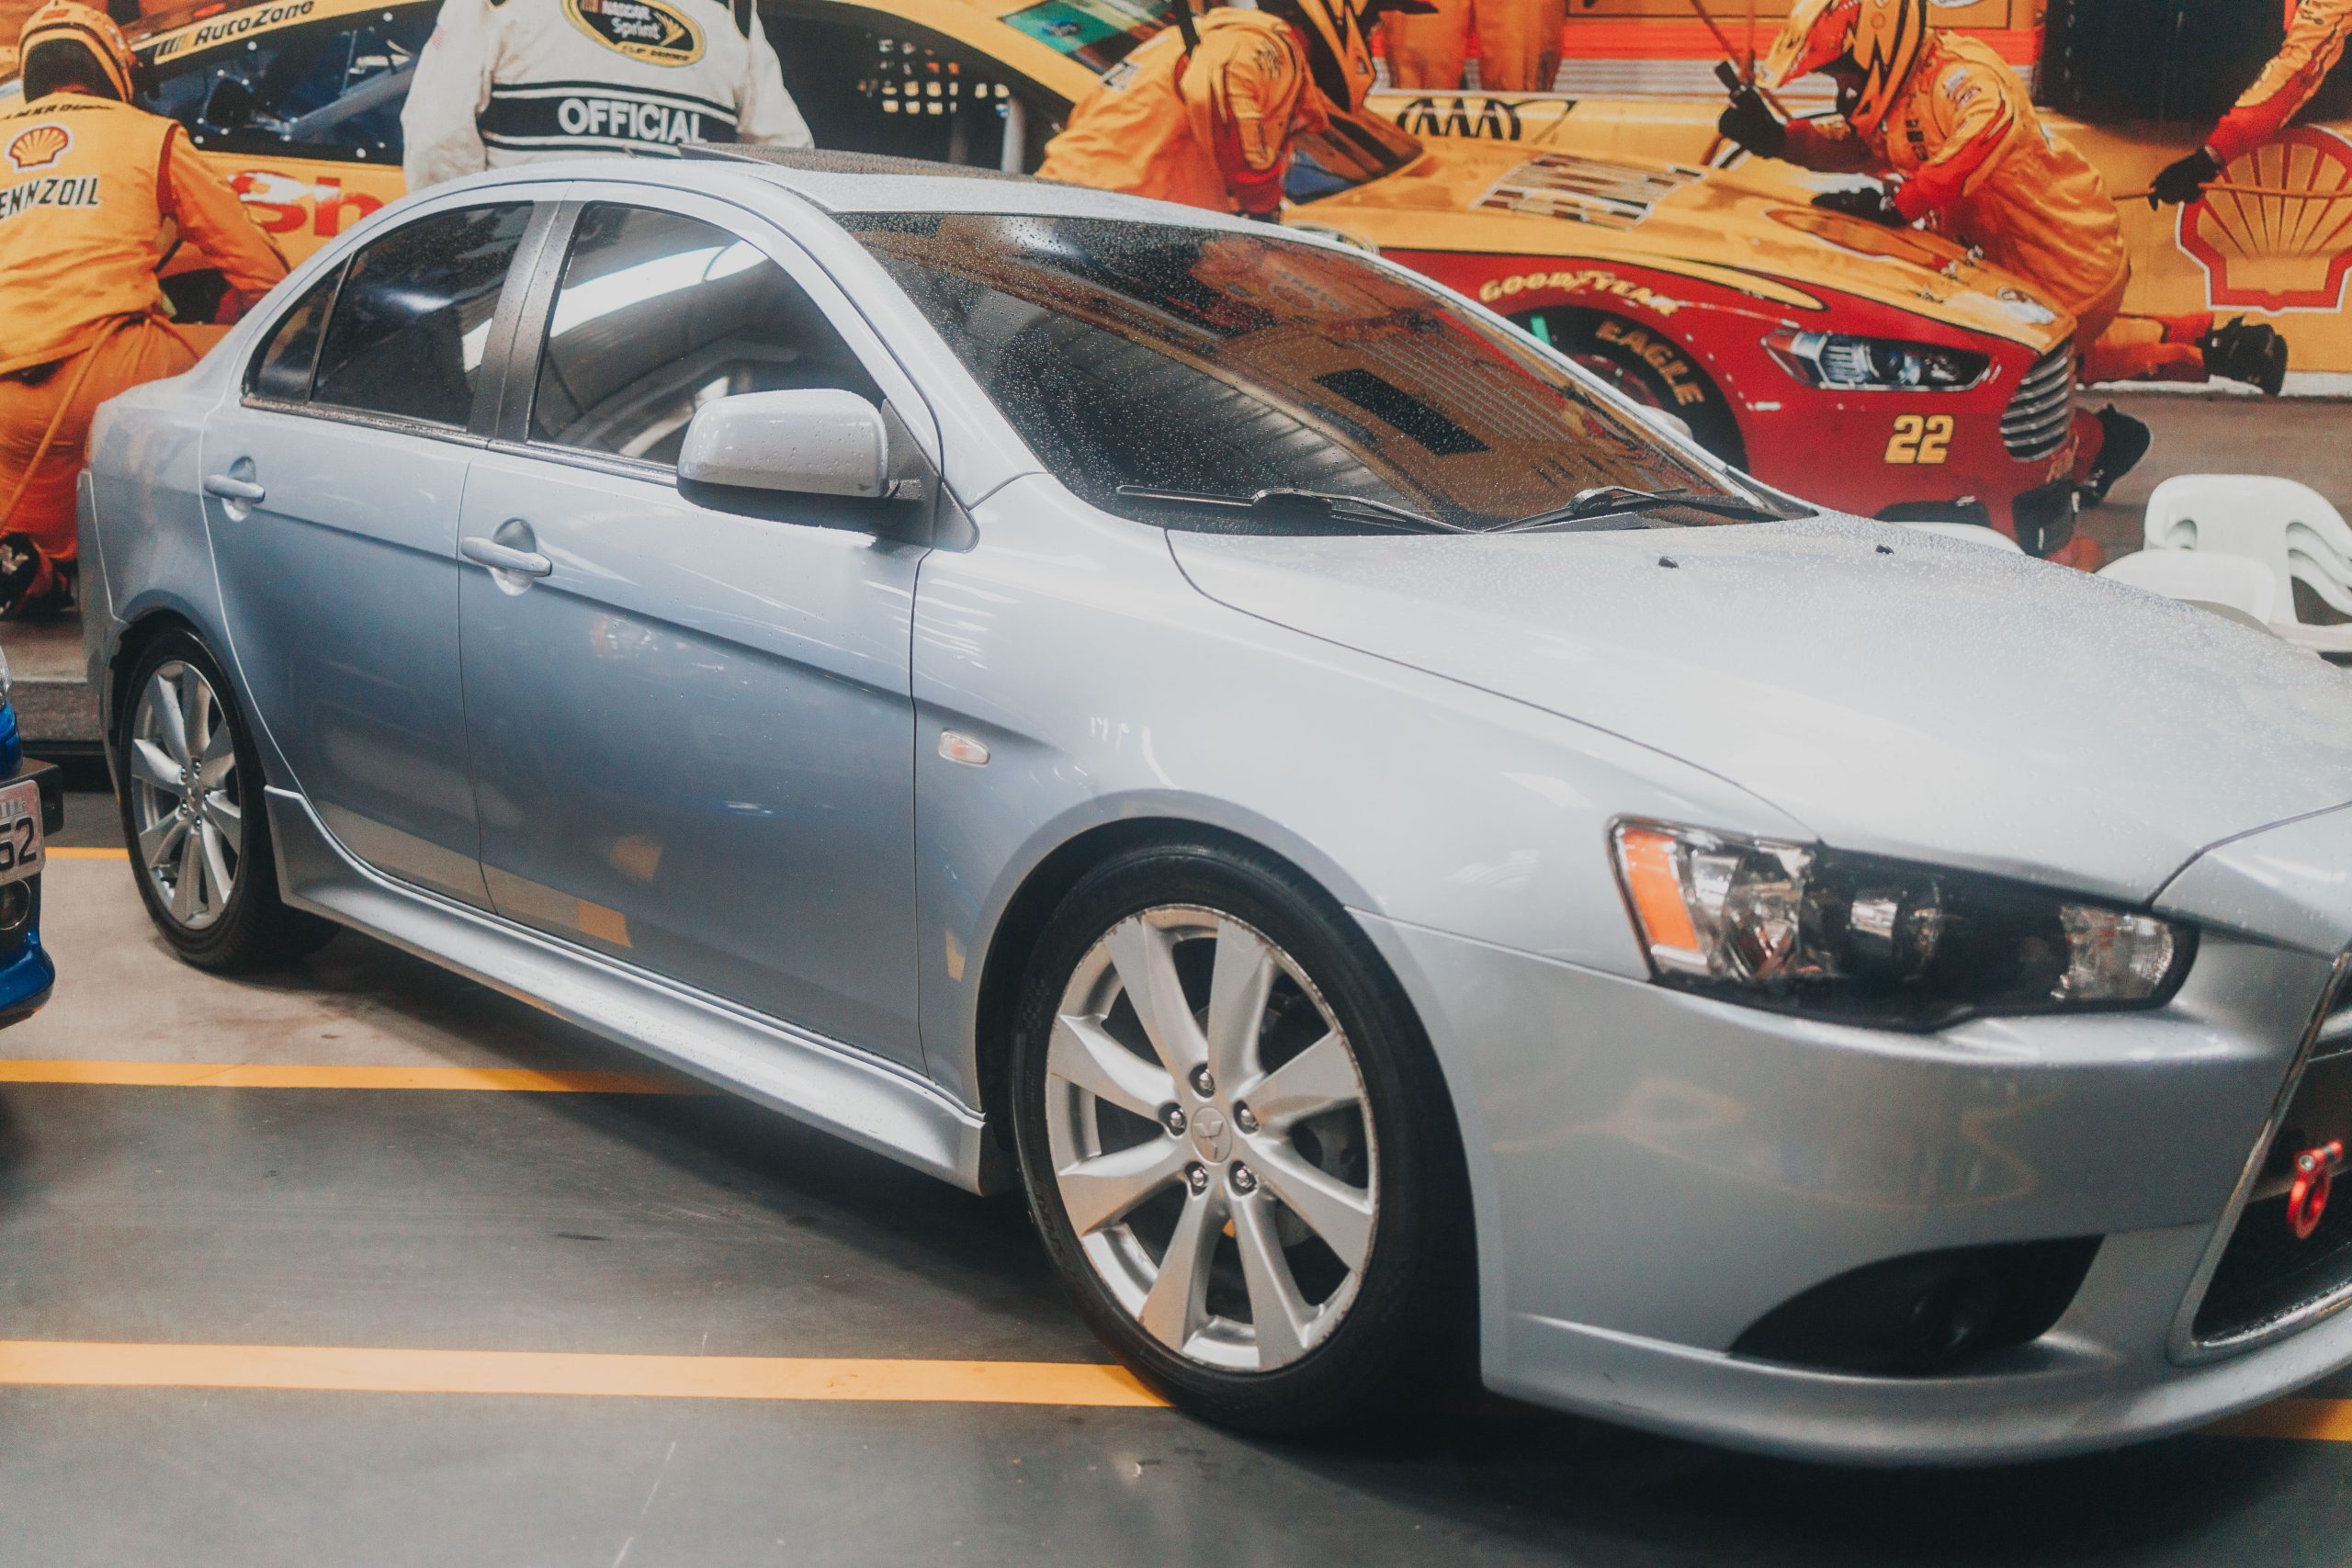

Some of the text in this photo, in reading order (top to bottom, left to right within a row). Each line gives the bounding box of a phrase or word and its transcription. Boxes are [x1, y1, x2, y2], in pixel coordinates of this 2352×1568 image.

[194, 1, 314, 46] AutoZone
[611, 17, 661, 39] Sprint
[558, 98, 707, 143] OFFICIAL
[1479, 270, 1679, 316] GOODYEAR
[1595, 321, 1704, 405] EAGLE
[1884, 414, 1954, 463] 22
